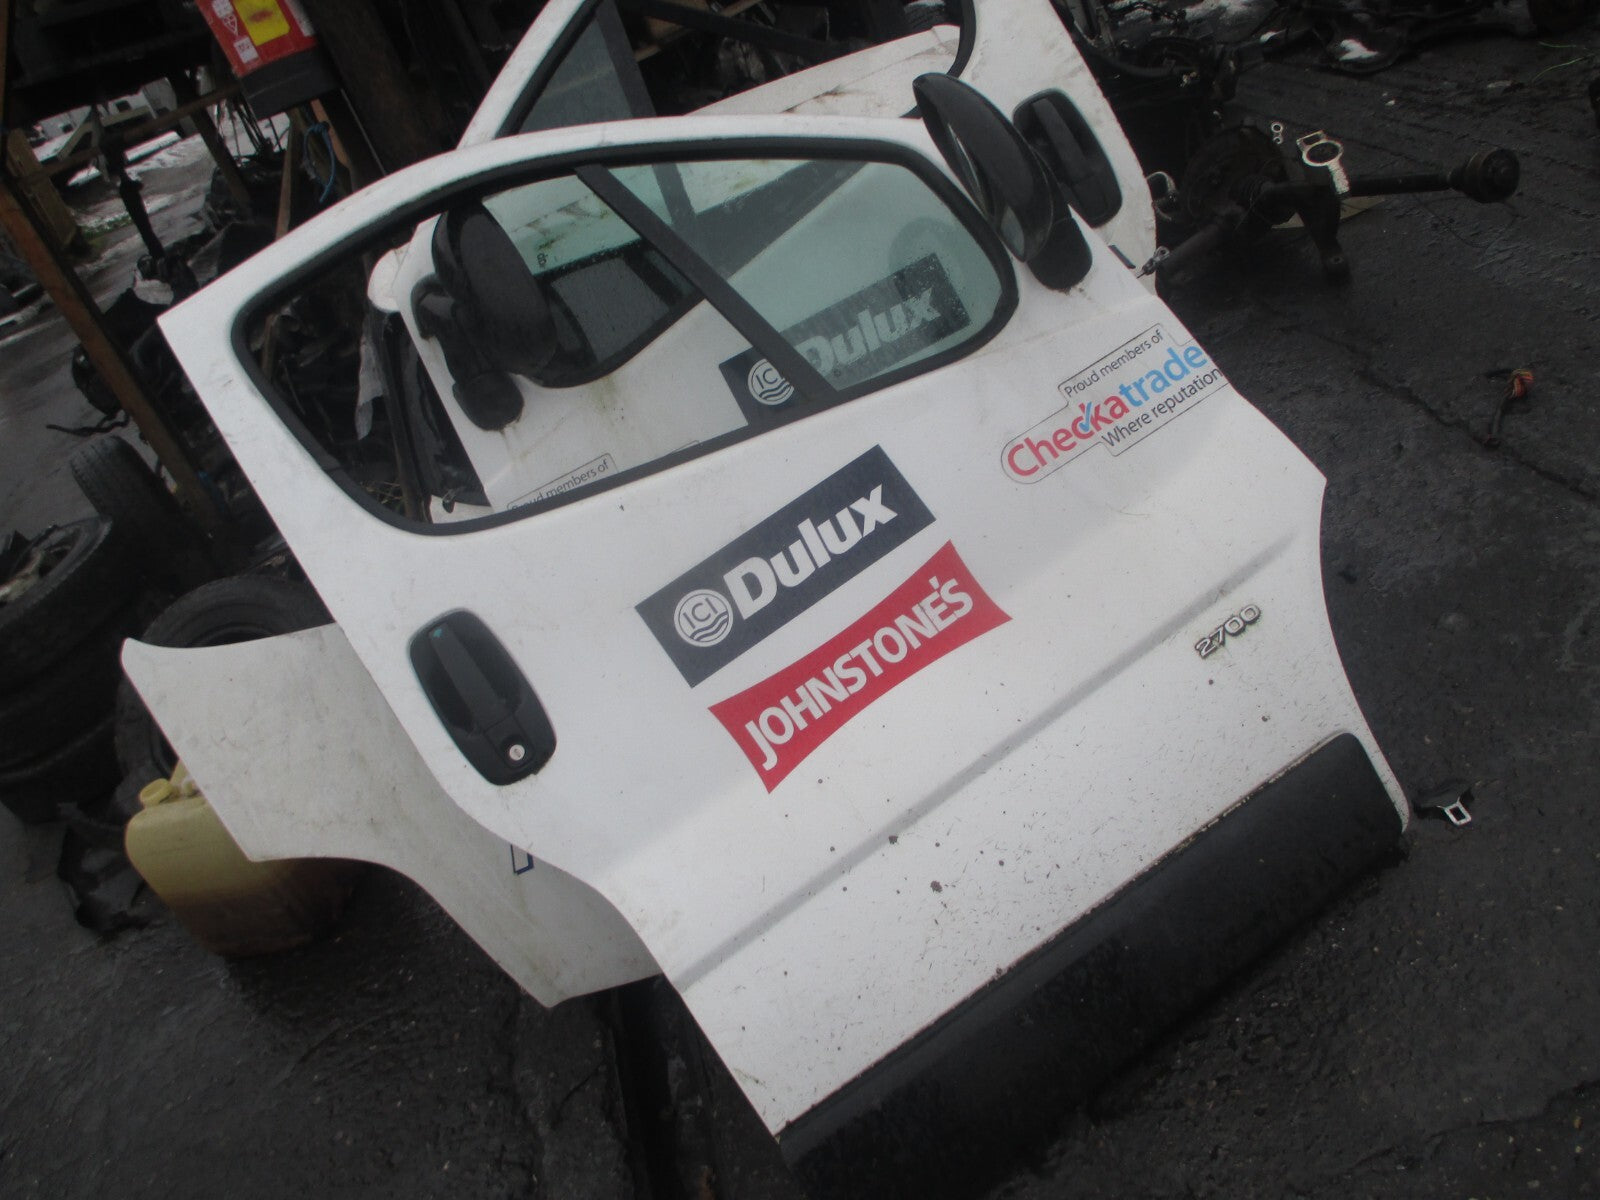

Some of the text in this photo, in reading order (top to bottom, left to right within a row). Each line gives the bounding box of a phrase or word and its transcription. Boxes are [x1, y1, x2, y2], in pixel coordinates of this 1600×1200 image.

[794, 287, 942, 377] Dulux
[1063, 328, 1165, 398] Proud members of
[1007, 345, 1208, 477] Checkatrade
[1101, 367, 1225, 447] Where reputation
[545, 458, 610, 497] members of
[683, 483, 899, 629] ICI Dulux
[744, 575, 974, 771] JOHNSTONE'S
[1194, 603, 1262, 660] 2700
